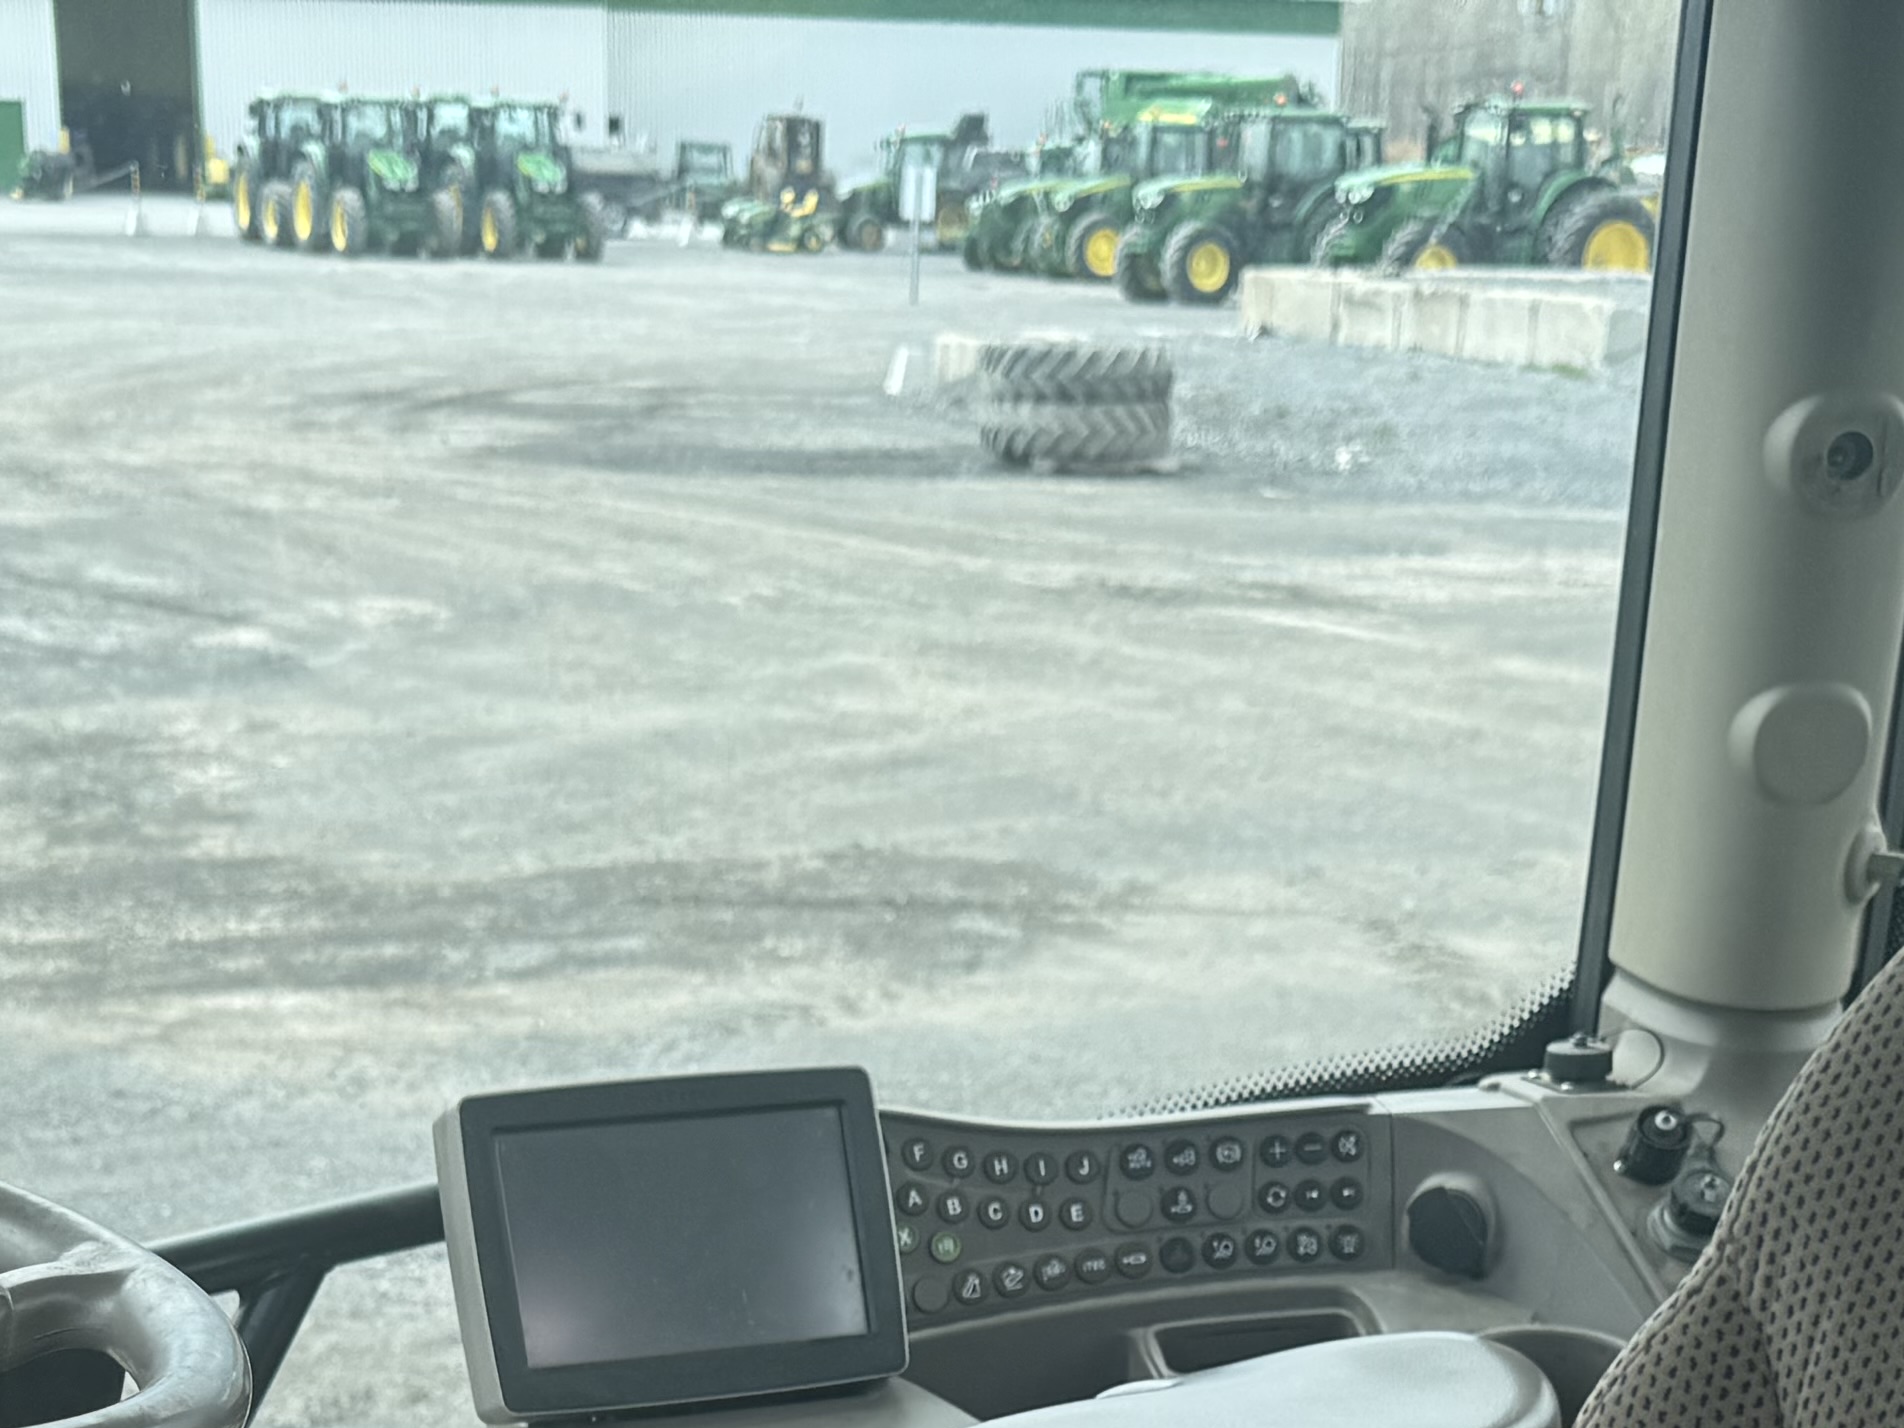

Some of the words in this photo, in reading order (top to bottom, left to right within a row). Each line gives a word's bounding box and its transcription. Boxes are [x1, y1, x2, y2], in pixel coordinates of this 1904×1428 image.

[912, 1142, 925, 1163] F
[952, 1151, 968, 1169] G
[994, 1156, 1009, 1176] H
[1039, 1158, 1046, 1177] I
[1078, 1156, 1090, 1175] J
[908, 1189, 923, 1208] A
[946, 1196, 961, 1216] B
[988, 1202, 1003, 1221] C
[1029, 1203, 1044, 1223] D
[1070, 1204, 1085, 1222] E
